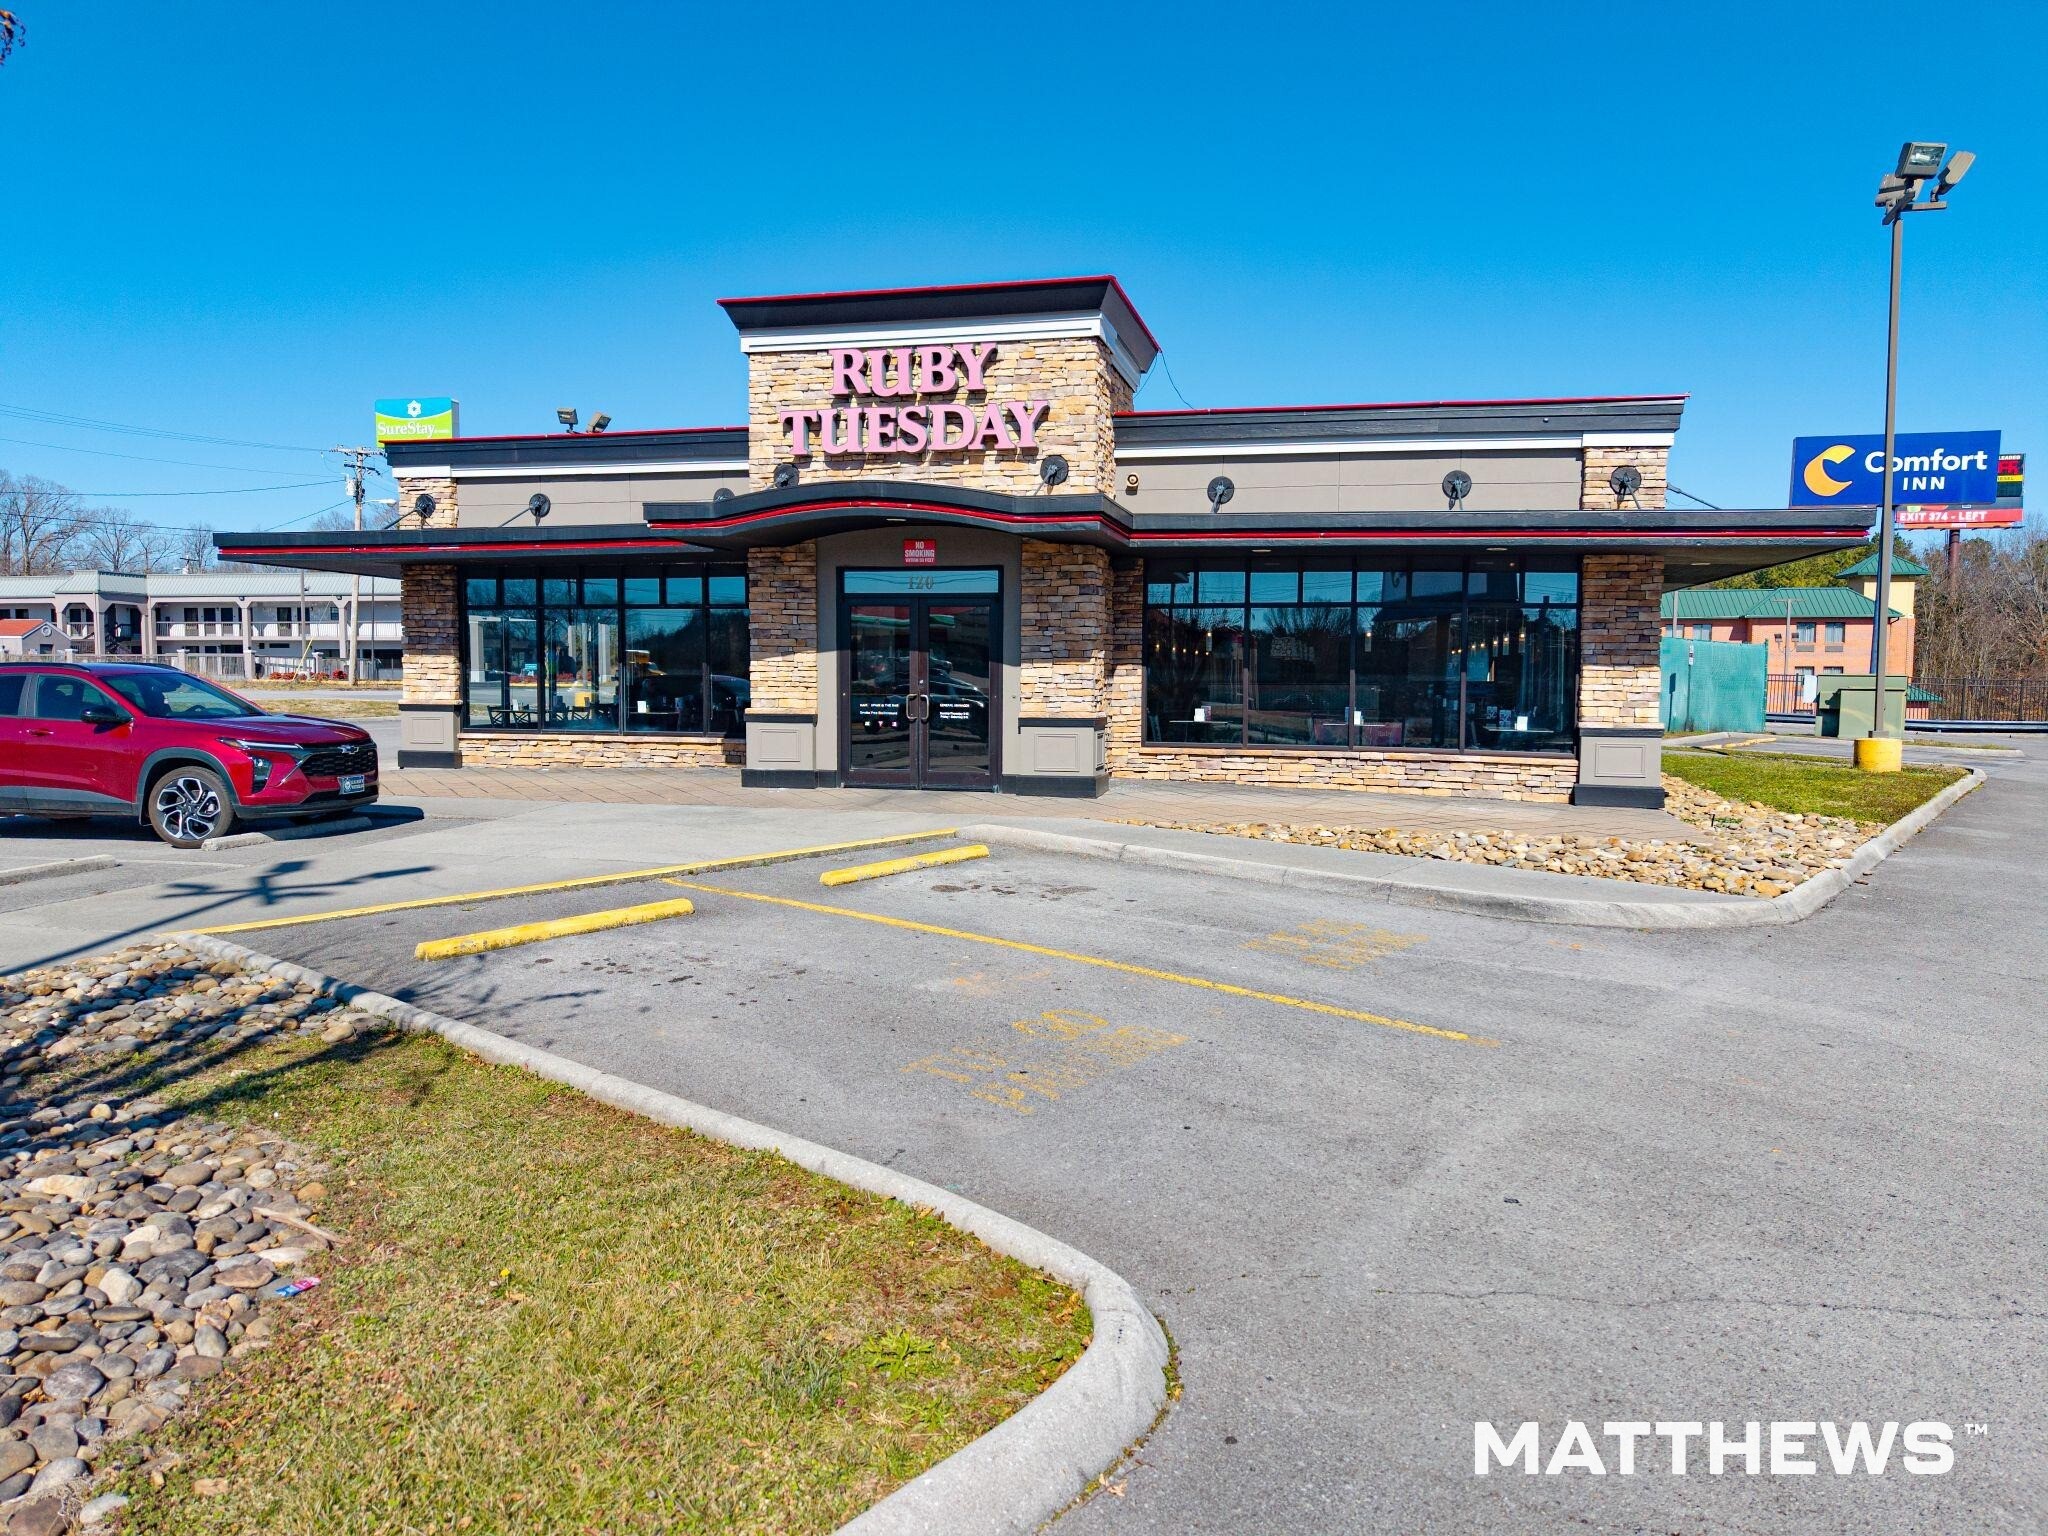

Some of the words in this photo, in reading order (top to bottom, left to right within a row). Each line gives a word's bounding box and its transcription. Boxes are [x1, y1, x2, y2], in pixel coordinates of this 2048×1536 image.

[828, 342, 998, 397] RUBY
[377, 421, 435, 439] SureStay
[779, 400, 1050, 456] TUESDAY
[1864, 448, 1988, 473] Comfort
[1902, 476, 1945, 491] INN
[1899, 512, 1927, 521] EXIT
[1928, 512, 1949, 521] 374
[1958, 511, 1988, 521] LEFT
[915, 541, 925, 549] NO
[904, 549, 935, 558] SMOKING
[907, 576, 935, 590] 120
